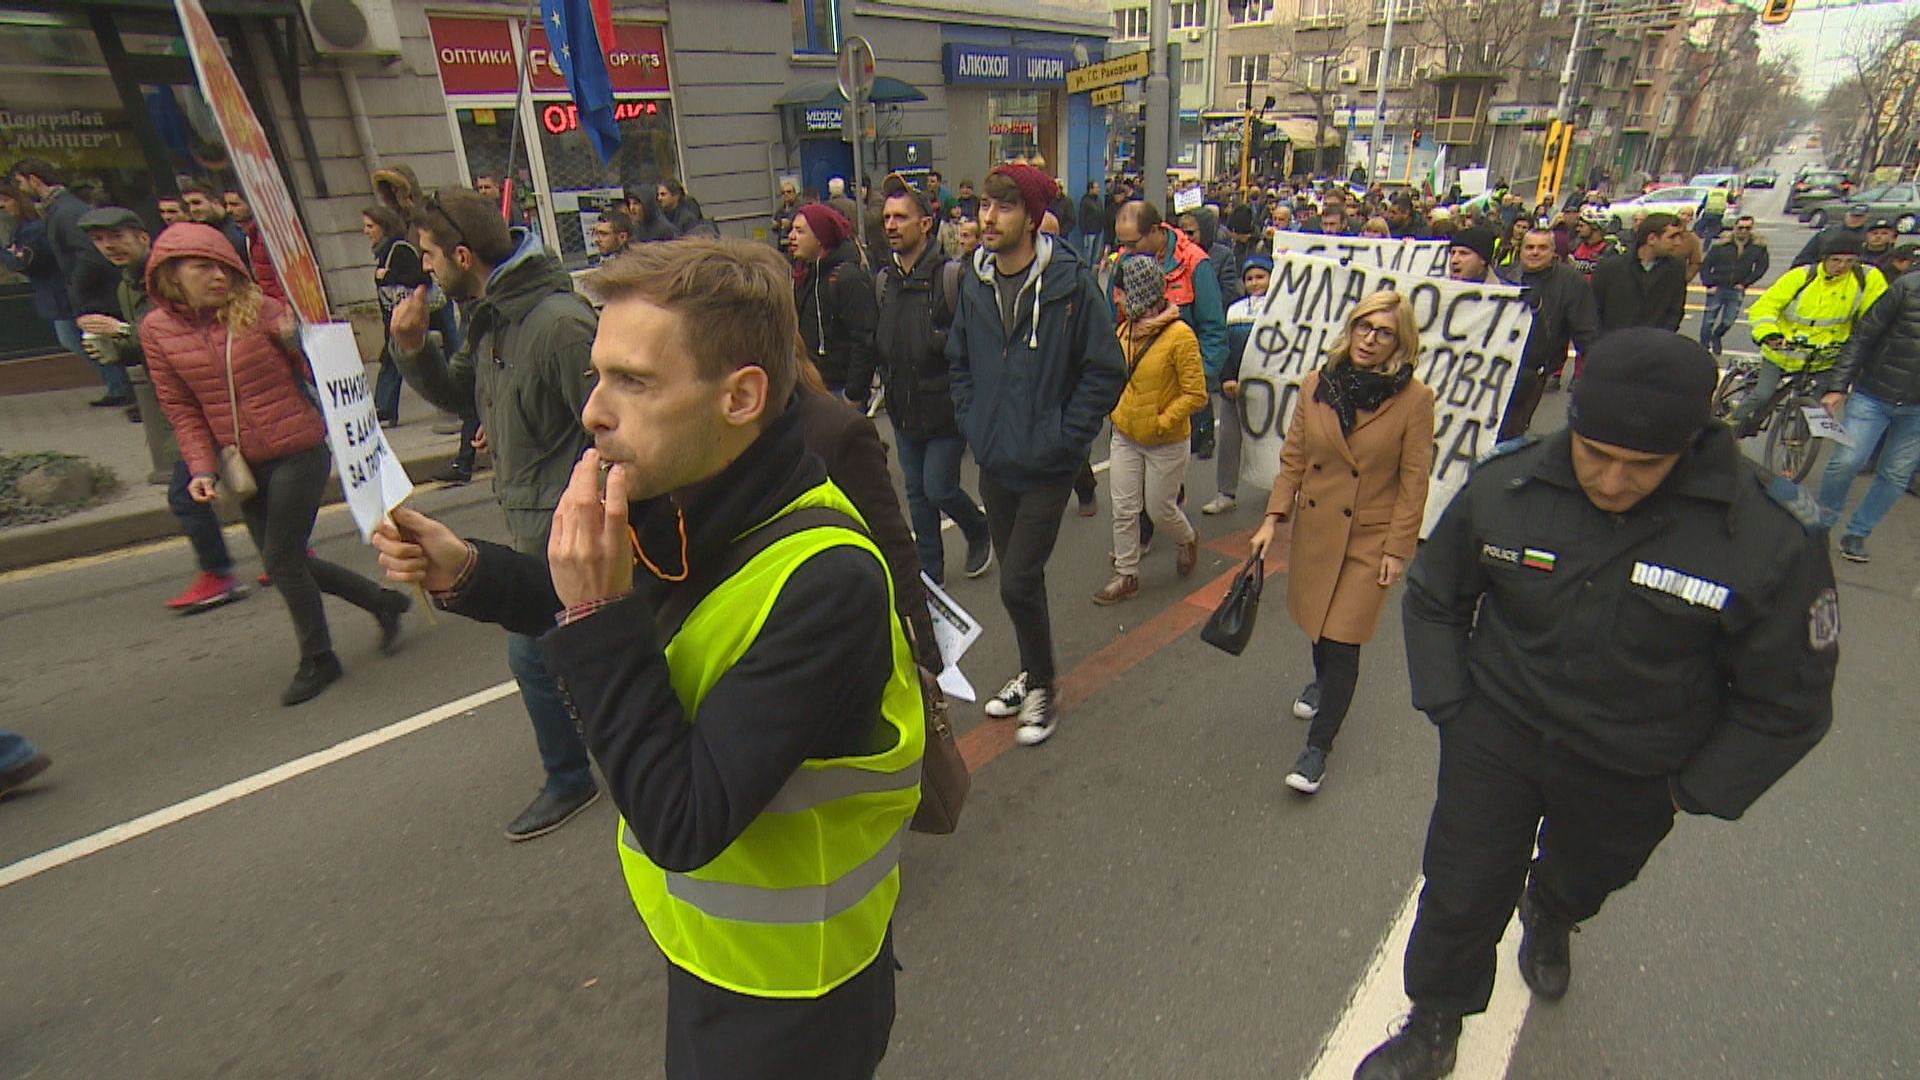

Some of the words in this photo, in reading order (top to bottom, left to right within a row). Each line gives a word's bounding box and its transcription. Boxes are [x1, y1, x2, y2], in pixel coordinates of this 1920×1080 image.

[440, 48, 512, 65] ОПТИКИ
[959, 54, 1009, 78] АЛКОХОЛ
[1027, 57, 1064, 82] ЦИГАРИ
[1483, 543, 1519, 563] POLICE
[1630, 560, 1730, 612] ПОЛИЦИЯ
